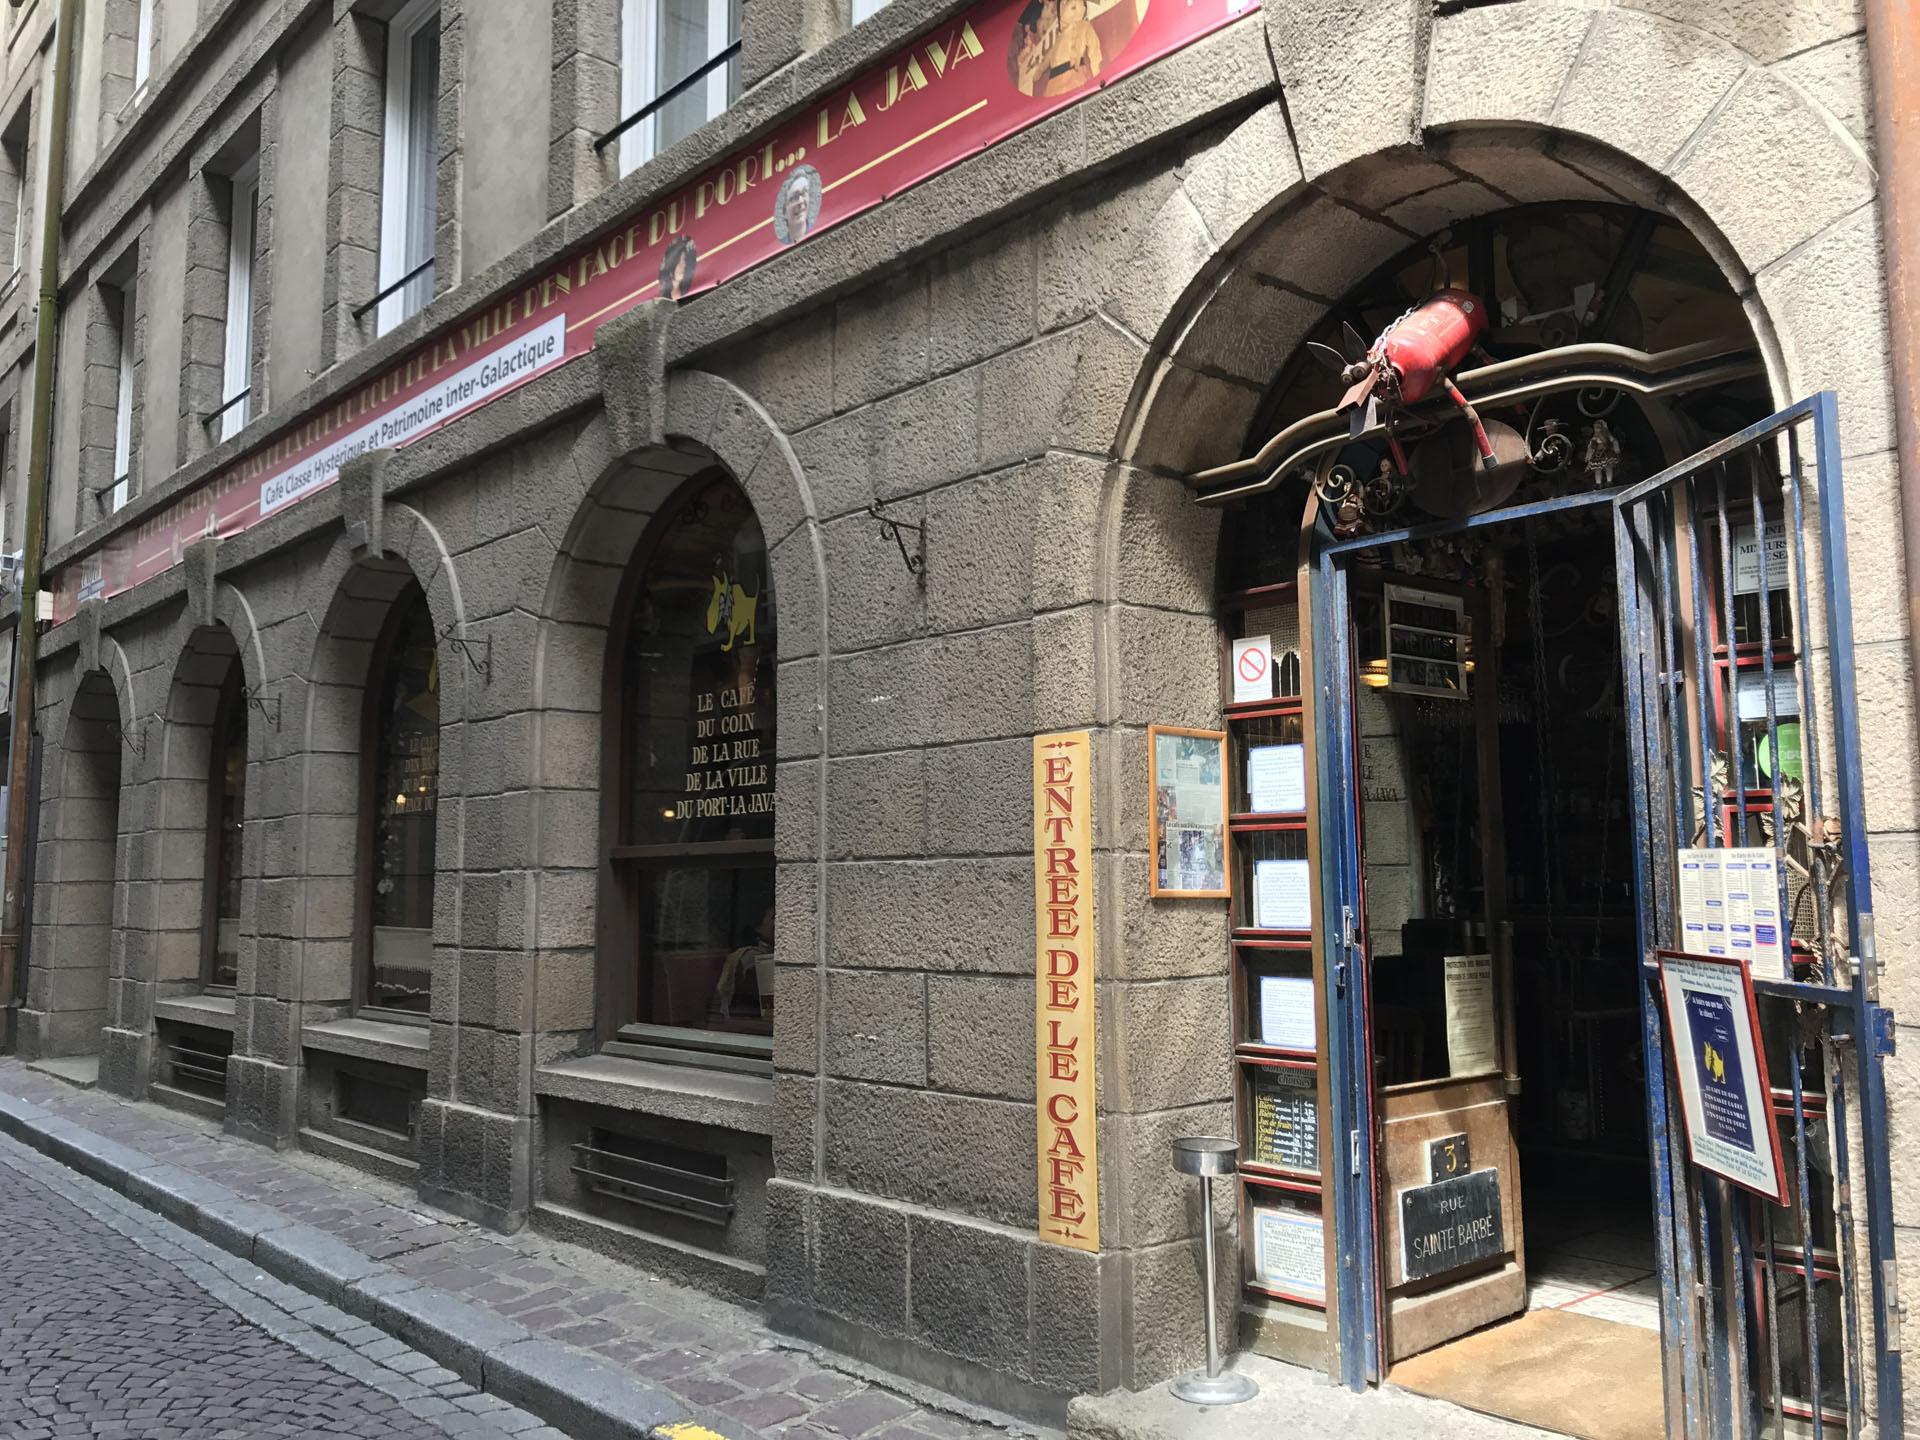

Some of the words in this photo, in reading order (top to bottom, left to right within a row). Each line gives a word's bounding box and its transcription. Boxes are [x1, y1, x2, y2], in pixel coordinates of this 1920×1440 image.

[432, 336, 457, 373] LA
[461, 298, 517, 352] VILLE
[523, 266, 571, 319] D'EN
[578, 224, 641, 288] FACE
[648, 195, 686, 247] DU
[817, 90, 867, 148] LA
[876, 20, 984, 112] JAVA
[265, 480, 283, 505] Café
[285, 464, 312, 495] Classé
[368, 430, 379, 450] et
[381, 396, 443, 443] Patrimoine
[446, 335, 555, 408] inter-Galactique
[1740, 540, 1787, 555] MIEURS
[697, 693, 714, 713] LE
[720, 683, 755, 709] CAFÉ
[697, 719, 716, 738] DU
[721, 712, 756, 733] COIN
[692, 745, 708, 765] DE
[712, 743, 730, 762] LA
[733, 739, 760, 759] RUE
[685, 772, 702, 792] DE
[705, 770, 724, 789] LA
[727, 765, 768, 787] VILLE
[676, 800, 694, 819] DU
[748, 791, 776, 813] JAVA
[1044, 756, 1080, 939] ENTREE
[1047, 949, 1080, 1011] DE
[1047, 1020, 1079, 1082] LE
[1259, 1101, 1275, 1111] Bière
[1259, 1109, 1276, 1119] Bière
[1259, 1117, 1268, 1126] Jus
[1276, 1120, 1292, 1132] fruits
[1259, 1126, 1275, 1135] Soda
[1259, 1133, 1272, 1143] Eau
[1047, 1093, 1086, 1225] CAFE
[1259, 1142, 1272, 1151] Eau
[1444, 1143, 1457, 1173] 3
[1440, 1195, 1466, 1214] RUE
[1413, 1227, 1456, 1259] SAINTE
[1458, 1215, 1495, 1246] BARBE
